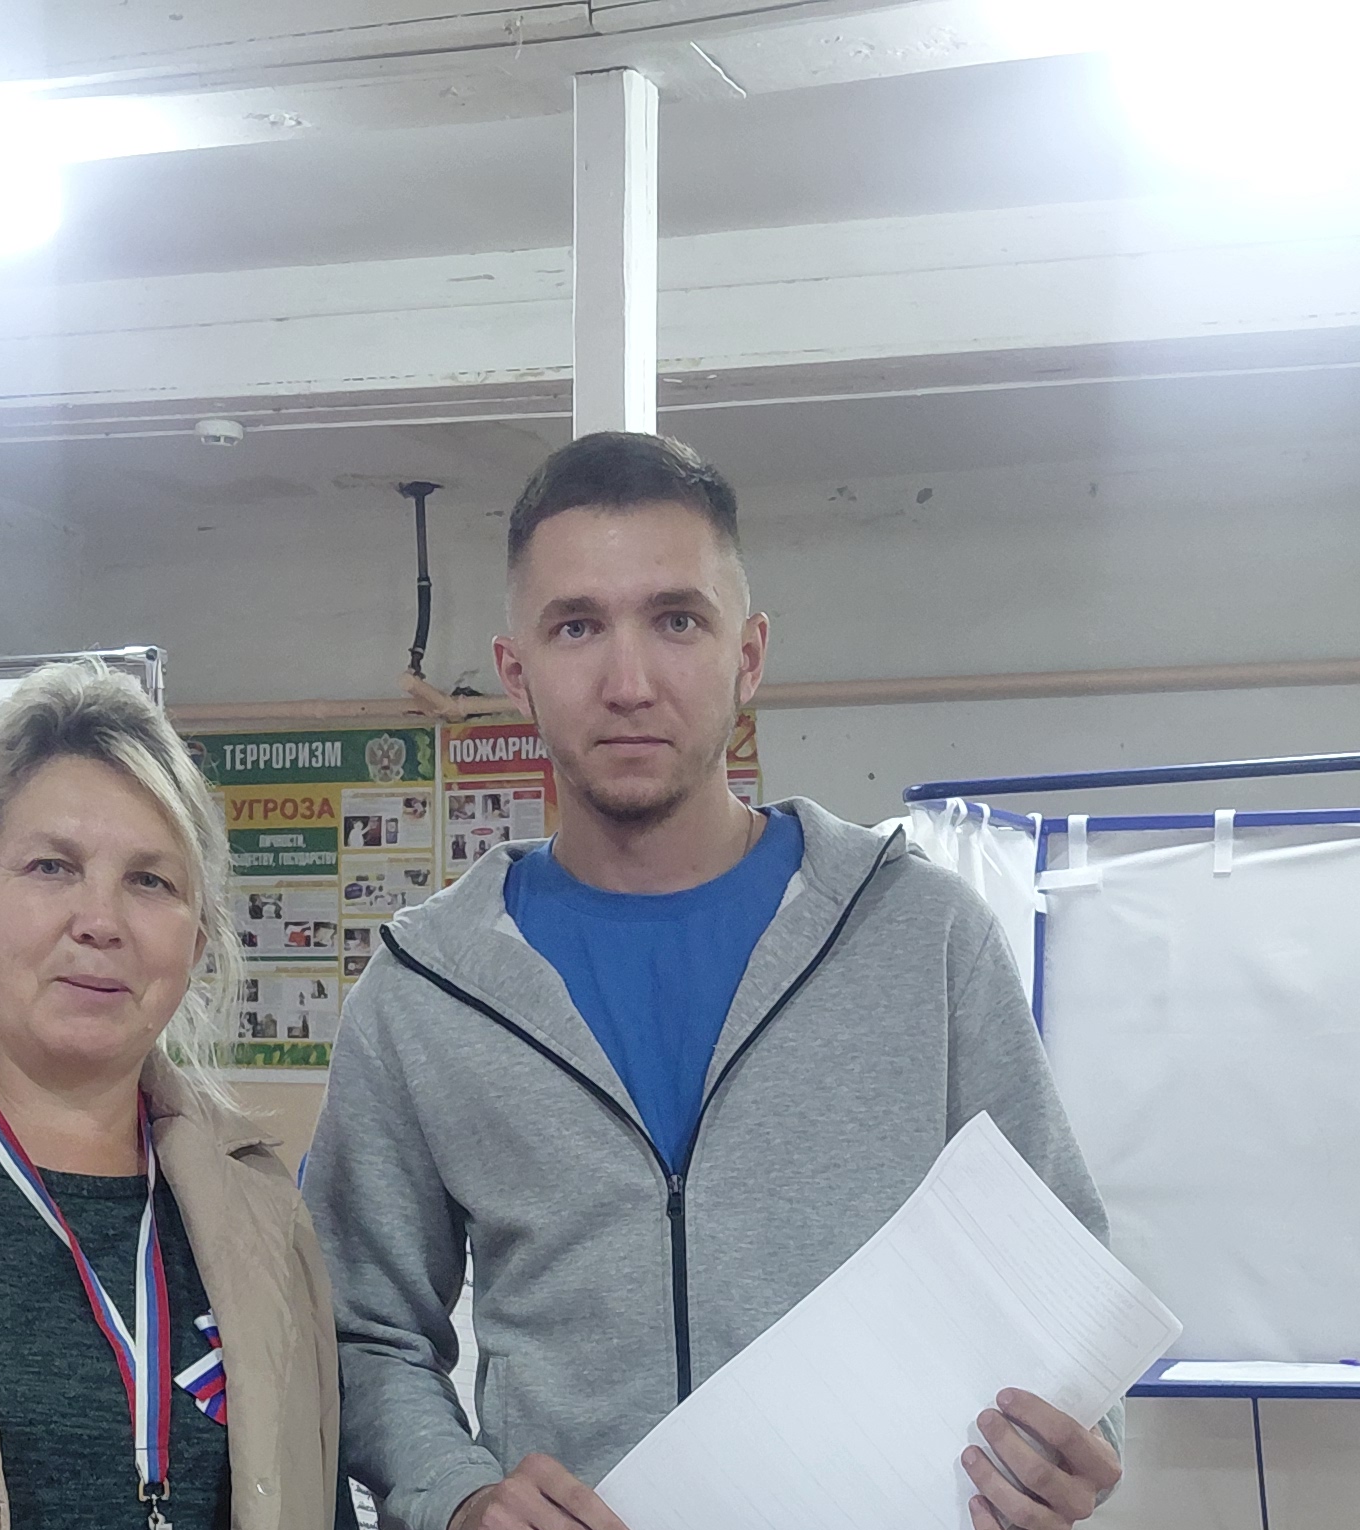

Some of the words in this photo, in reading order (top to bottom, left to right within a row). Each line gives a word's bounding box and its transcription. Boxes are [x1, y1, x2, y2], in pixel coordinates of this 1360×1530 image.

[223, 741, 342, 771] ТЕРРОРИЗМ
[448, 736, 548, 764] ПОЖАРНА
[230, 797, 336, 821] УГРОЗА
